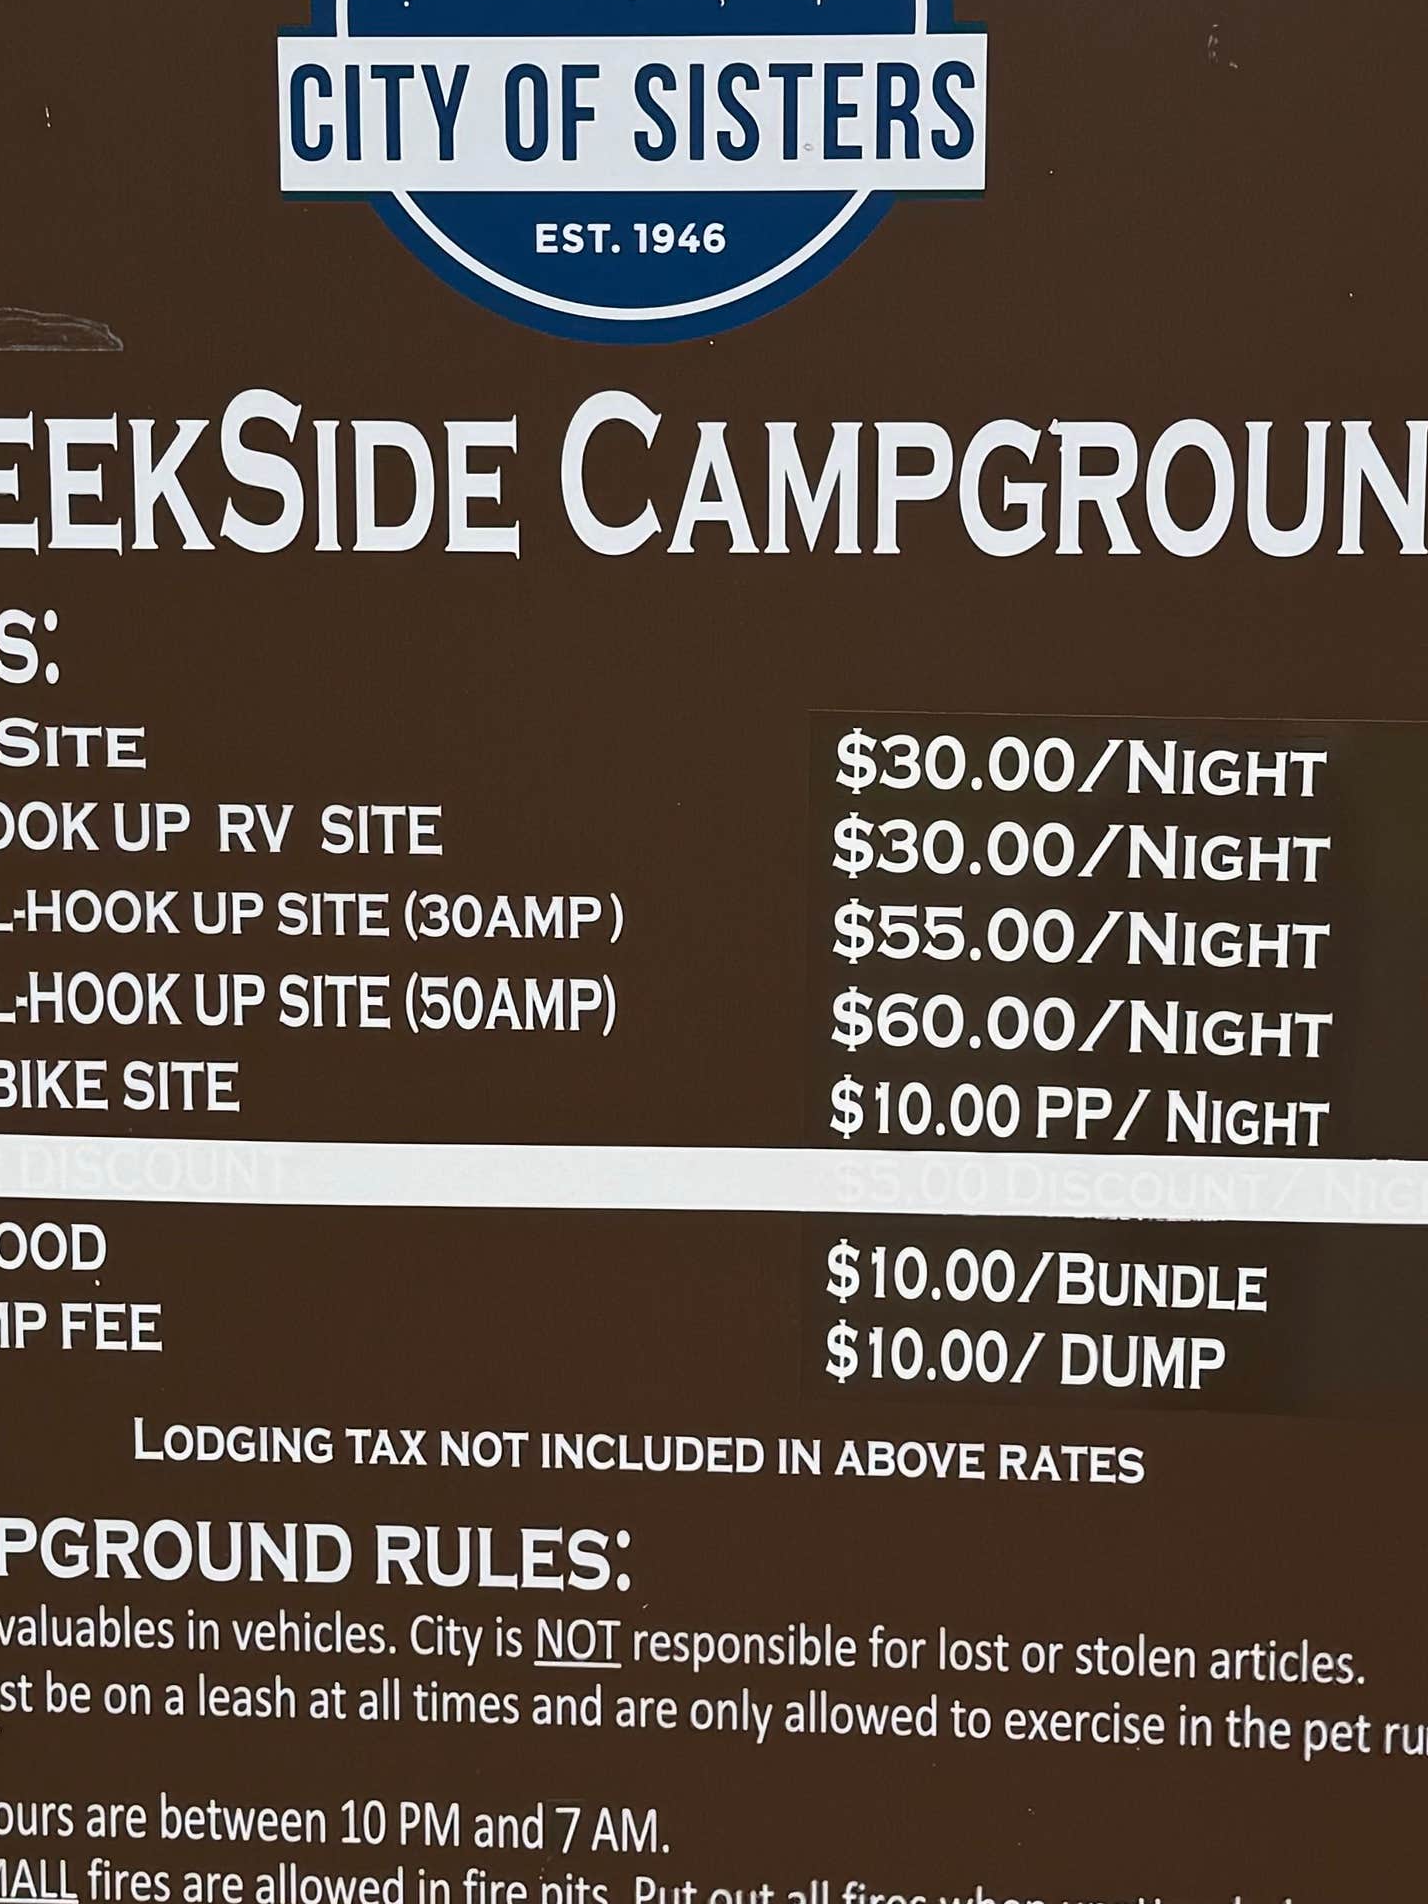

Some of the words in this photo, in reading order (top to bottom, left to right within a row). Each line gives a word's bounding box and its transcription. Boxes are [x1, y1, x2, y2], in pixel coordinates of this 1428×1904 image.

[289, 63, 470, 162] CITY
[503, 63, 601, 162] OF
[633, 60, 975, 162] SISTERS
[536, 224, 620, 253] EST.
[634, 223, 725, 253] 1946
[114, 803, 190, 851] UP
[218, 804, 294, 852] RV
[322, 805, 442, 855] SITE
[193, 892, 263, 934] UP
[278, 893, 389, 936] SITE
[405, 890, 623, 943] (30AMP)
[195, 974, 265, 1026] UP
[280, 975, 390, 1029] SITE
[406, 972, 615, 1036] (50AMP)
[124, 1061, 239, 1112] SITE
[62, 1303, 162, 1351] FEE
[826, 1319, 1045, 1383] $10.00/
[1061, 1333, 1225, 1389] DUMP
[134, 1417, 333, 1463] LODGING
[346, 1429, 427, 1465] TAX
[441, 1431, 528, 1467] NOT
[542, 1434, 764, 1473] INCLUDED
[779, 1439, 820, 1474] IN
[835, 1441, 985, 1480] ABOVE
[1000, 1445, 1144, 1483] RATES
[188, 1609, 219, 1650] in
[233, 1609, 396, 1653] vehicles.
[411, 1615, 482, 1666] City
[496, 1617, 522, 1657] is
[538, 1619, 621, 1659] NOT
[634, 1623, 856, 1672] responsible
[869, 1625, 926, 1668] for
[940, 1627, 1009, 1672] lost
[1022, 1643, 1063, 1673] or
[1076, 1634, 1195, 1678] stolen
[1210, 1639, 1364, 1684] articles.
[47, 1670, 90, 1713] be
[105, 1684, 150, 1714] on
[165, 1685, 183, 1715] a
[199, 1673, 295, 1717] leash
[310, 1682, 346, 1719] at
[359, 1678, 399, 1720] all
[413, 1681, 519, 1724] times
[533, 1684, 601, 1726] and
[616, 1697, 677, 1728] are
[691, 1688, 772, 1743] only
[785, 1690, 936, 1736] allowed
[950, 1700, 991, 1738] to
[1005, 1702, 1164, 1744] exercise
[1180, 1705, 1211, 1746] in
[1226, 1705, 1290, 1749] the
[1305, 1715, 1371, 1761] pet
[87, 1804, 146, 1838] are
[161, 1792, 325, 1843] between
[342, 1800, 385, 1844] 10
[401, 1802, 459, 1846] PM
[475, 1803, 543, 1849] and
[556, 1808, 580, 1853] 7
[592, 1808, 669, 1853] AM.
[88, 1858, 170, 1901] fires
[184, 1873, 243, 1903] are
